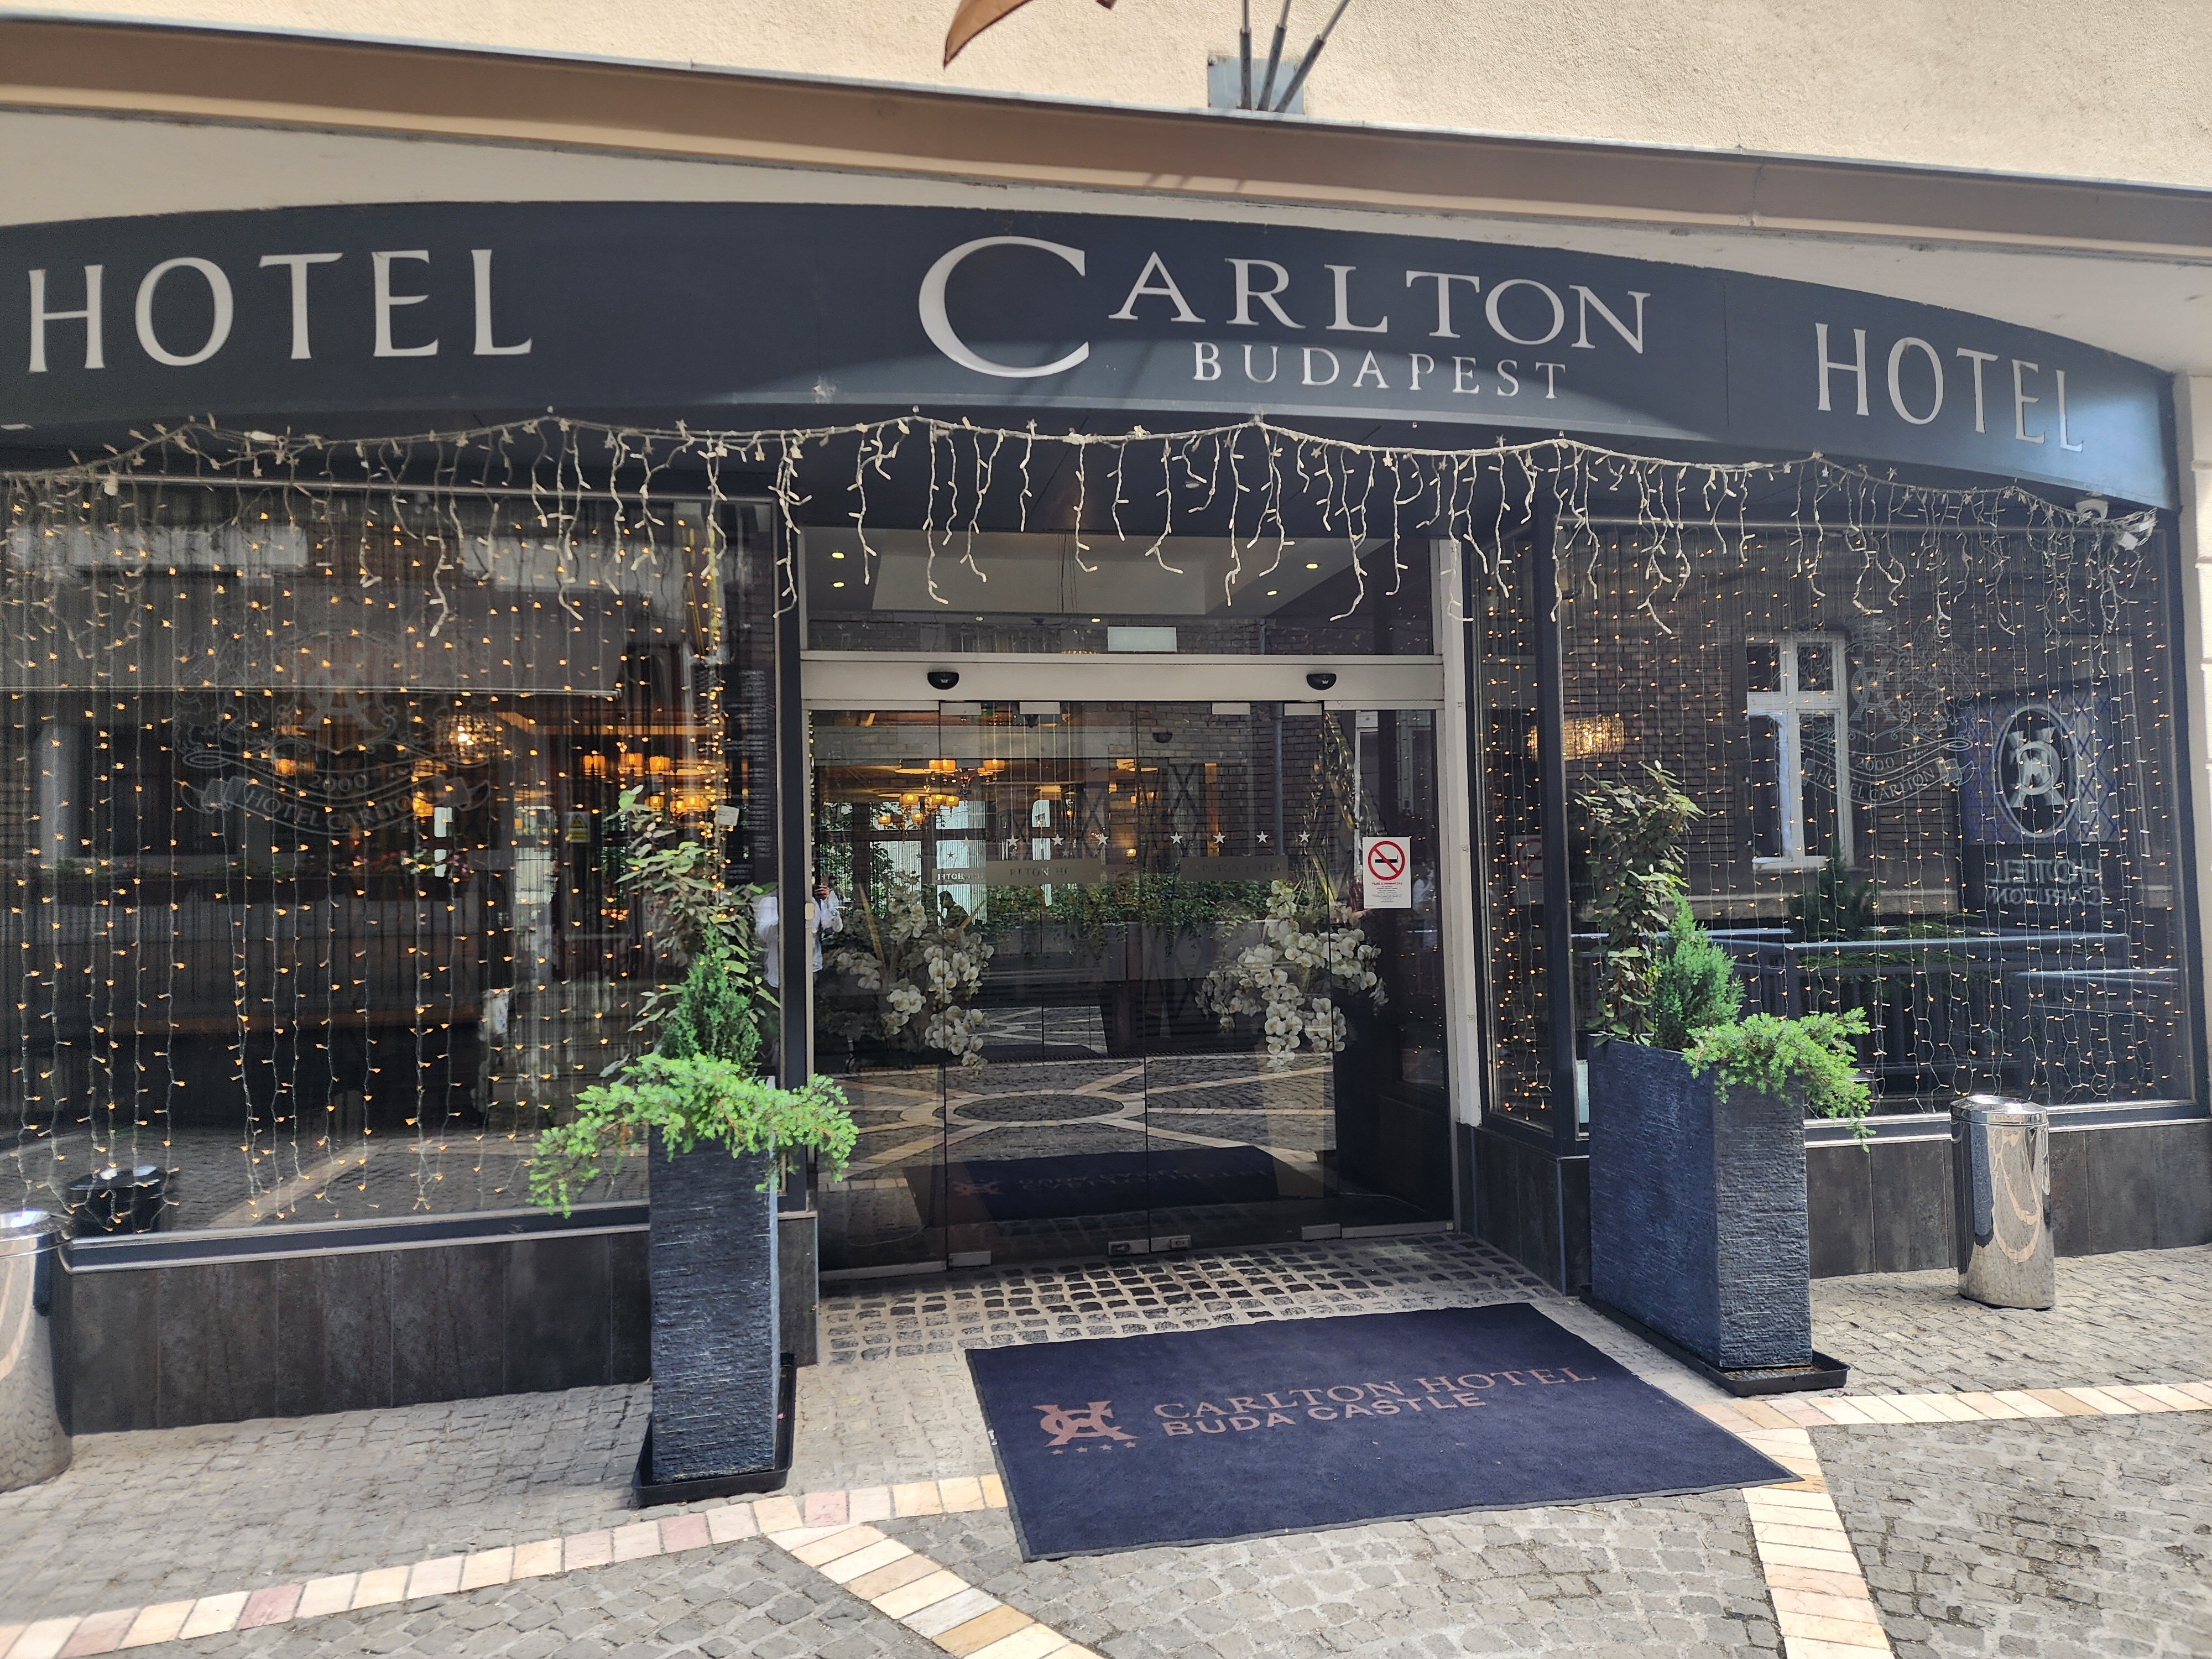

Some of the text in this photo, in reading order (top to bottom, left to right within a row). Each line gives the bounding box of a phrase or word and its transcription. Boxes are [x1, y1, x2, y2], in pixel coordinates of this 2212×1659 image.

[29, 249, 532, 373] HOTEL
[919, 236, 1651, 378] CARLTON
[1193, 341, 1566, 400] BUDAPEST
[1815, 322, 2084, 452] HOTEL
[309, 774, 367, 792] 2000
[1816, 767, 1936, 801] HOEL CARLTON
[1855, 757, 1895, 771] 2000
[246, 789, 416, 830] HOTEL CARLTO
[1154, 1366, 1598, 1419] CARLTON HOTEL
[1161, 1392, 1487, 1437] BUDA CASTLE
